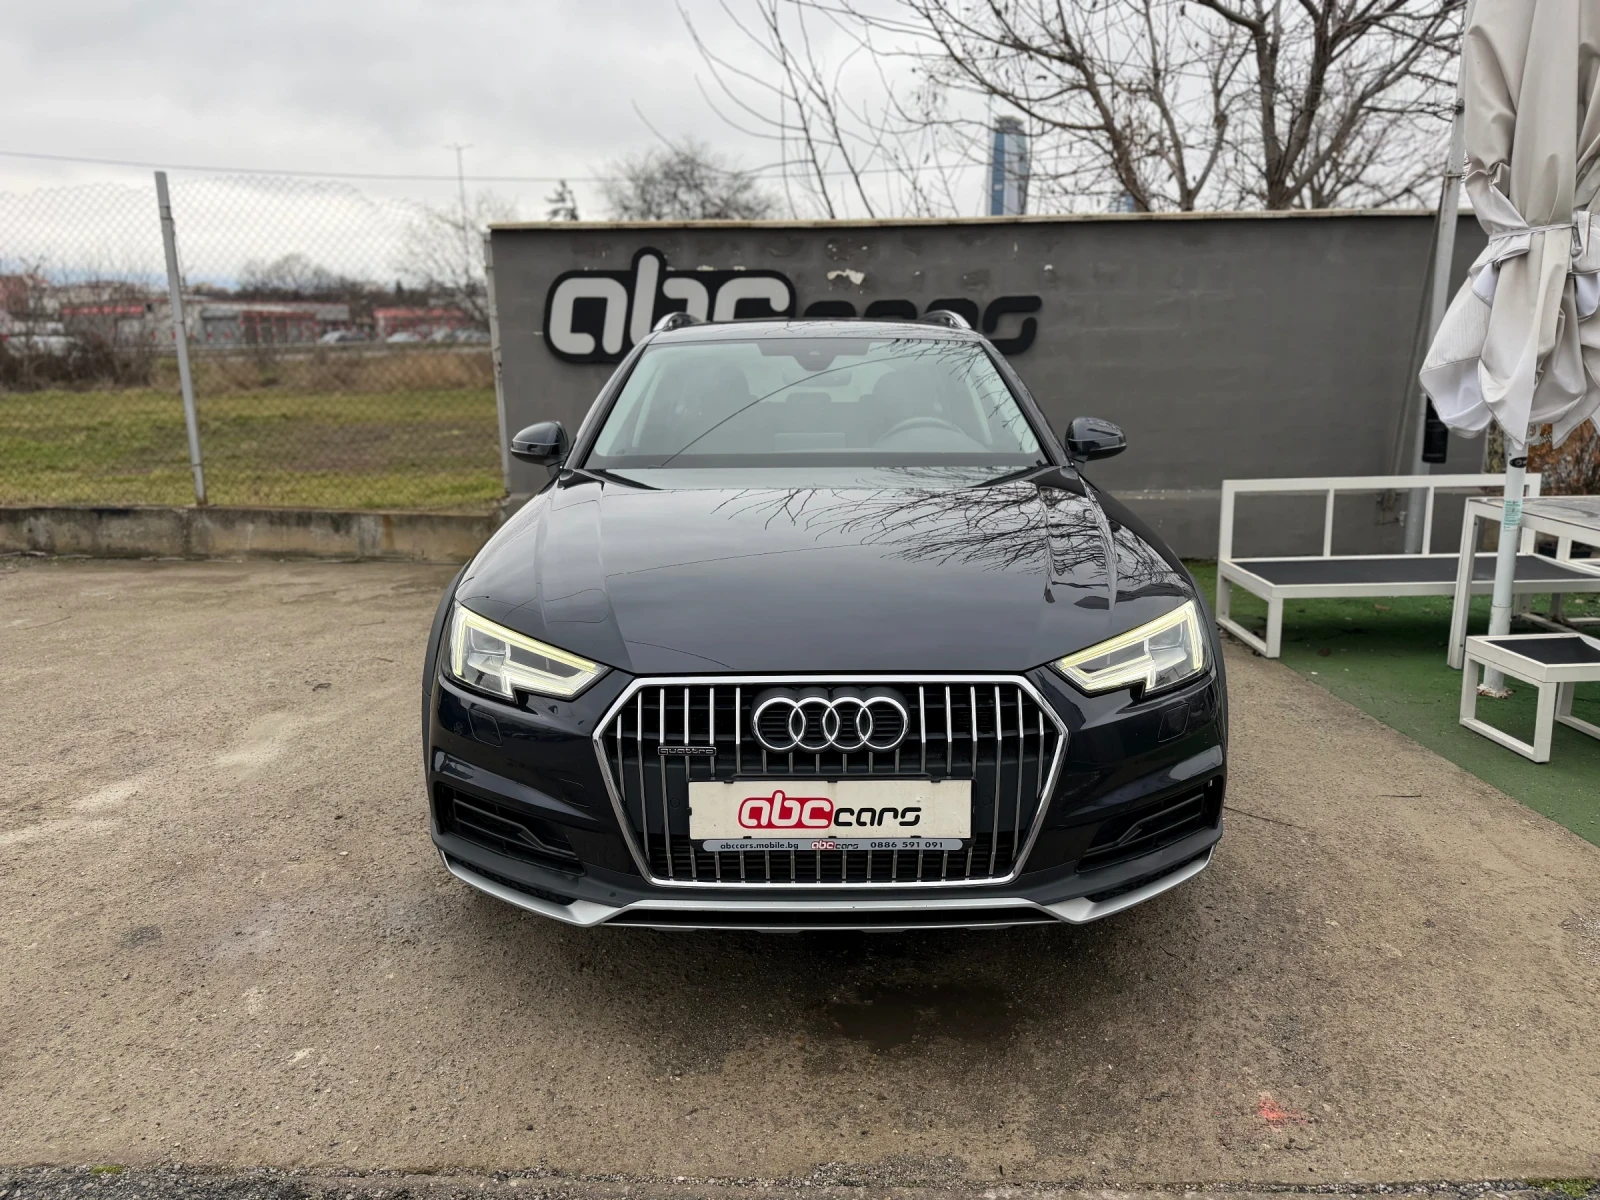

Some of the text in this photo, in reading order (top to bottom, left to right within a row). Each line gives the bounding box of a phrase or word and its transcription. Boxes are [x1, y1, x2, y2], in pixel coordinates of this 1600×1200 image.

[659, 747, 714, 755] quattro
[740, 790, 922, 828] abc cars
[720, 839, 799, 850] abccars.mobile.bg
[811, 840, 835, 849] abc
